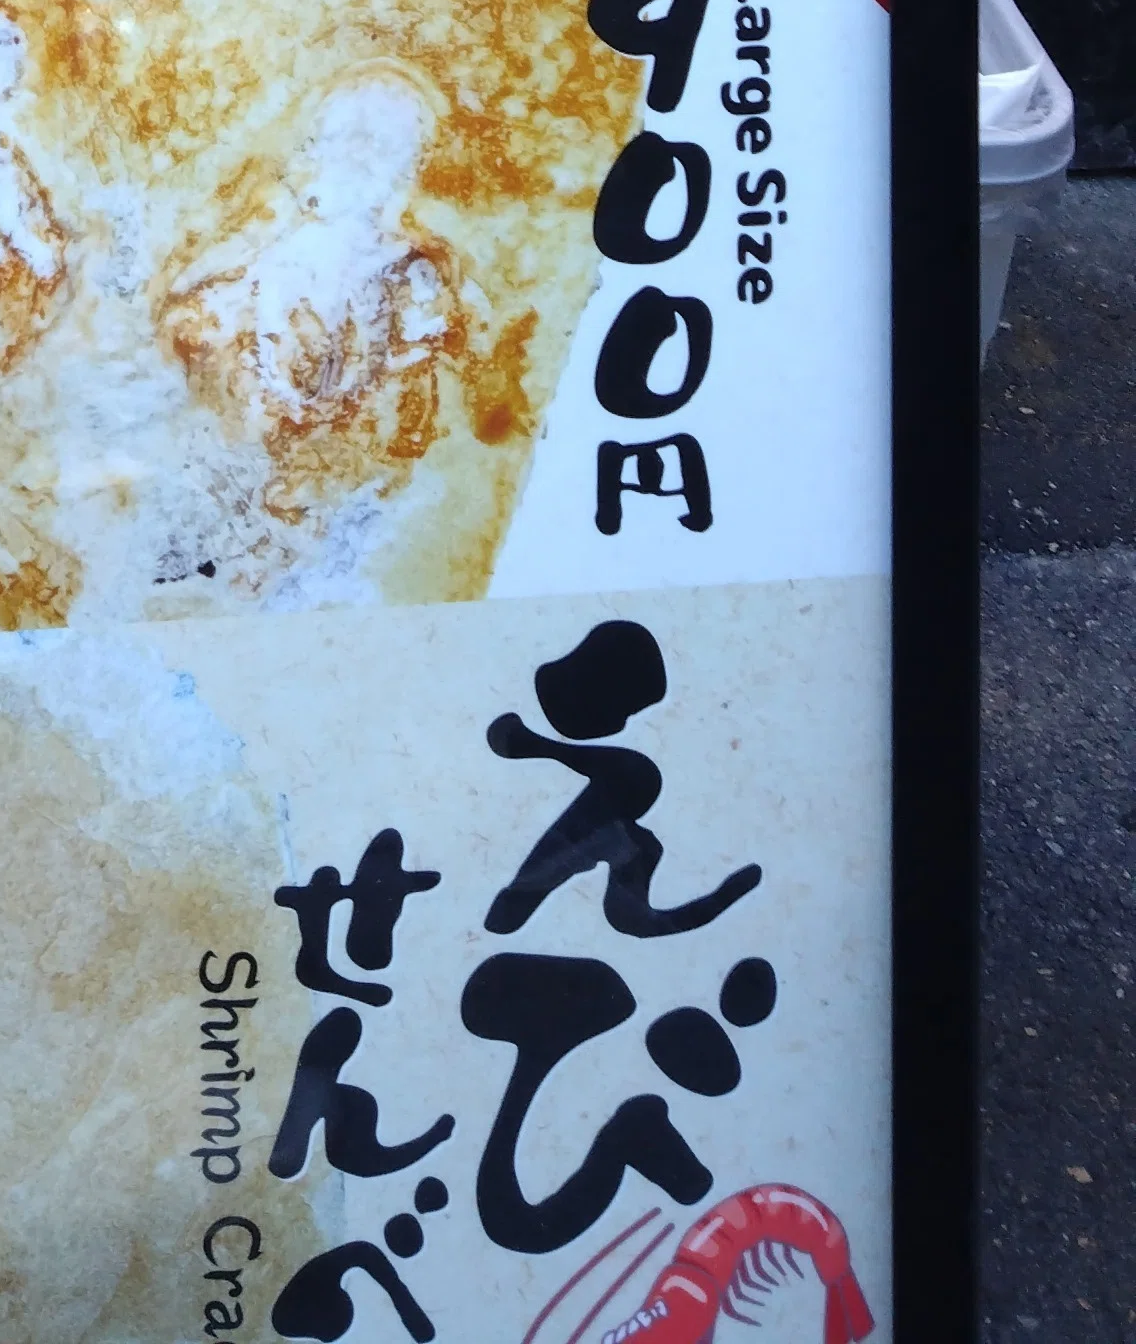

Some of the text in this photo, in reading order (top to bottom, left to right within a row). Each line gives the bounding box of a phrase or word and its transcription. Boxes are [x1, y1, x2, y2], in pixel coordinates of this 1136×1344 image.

[736, 169, 787, 305] Size
[189, 950, 263, 1344] Shrimp Cra
[268, 828, 457, 1343] せんべ
[461, 620, 777, 1254] えび
